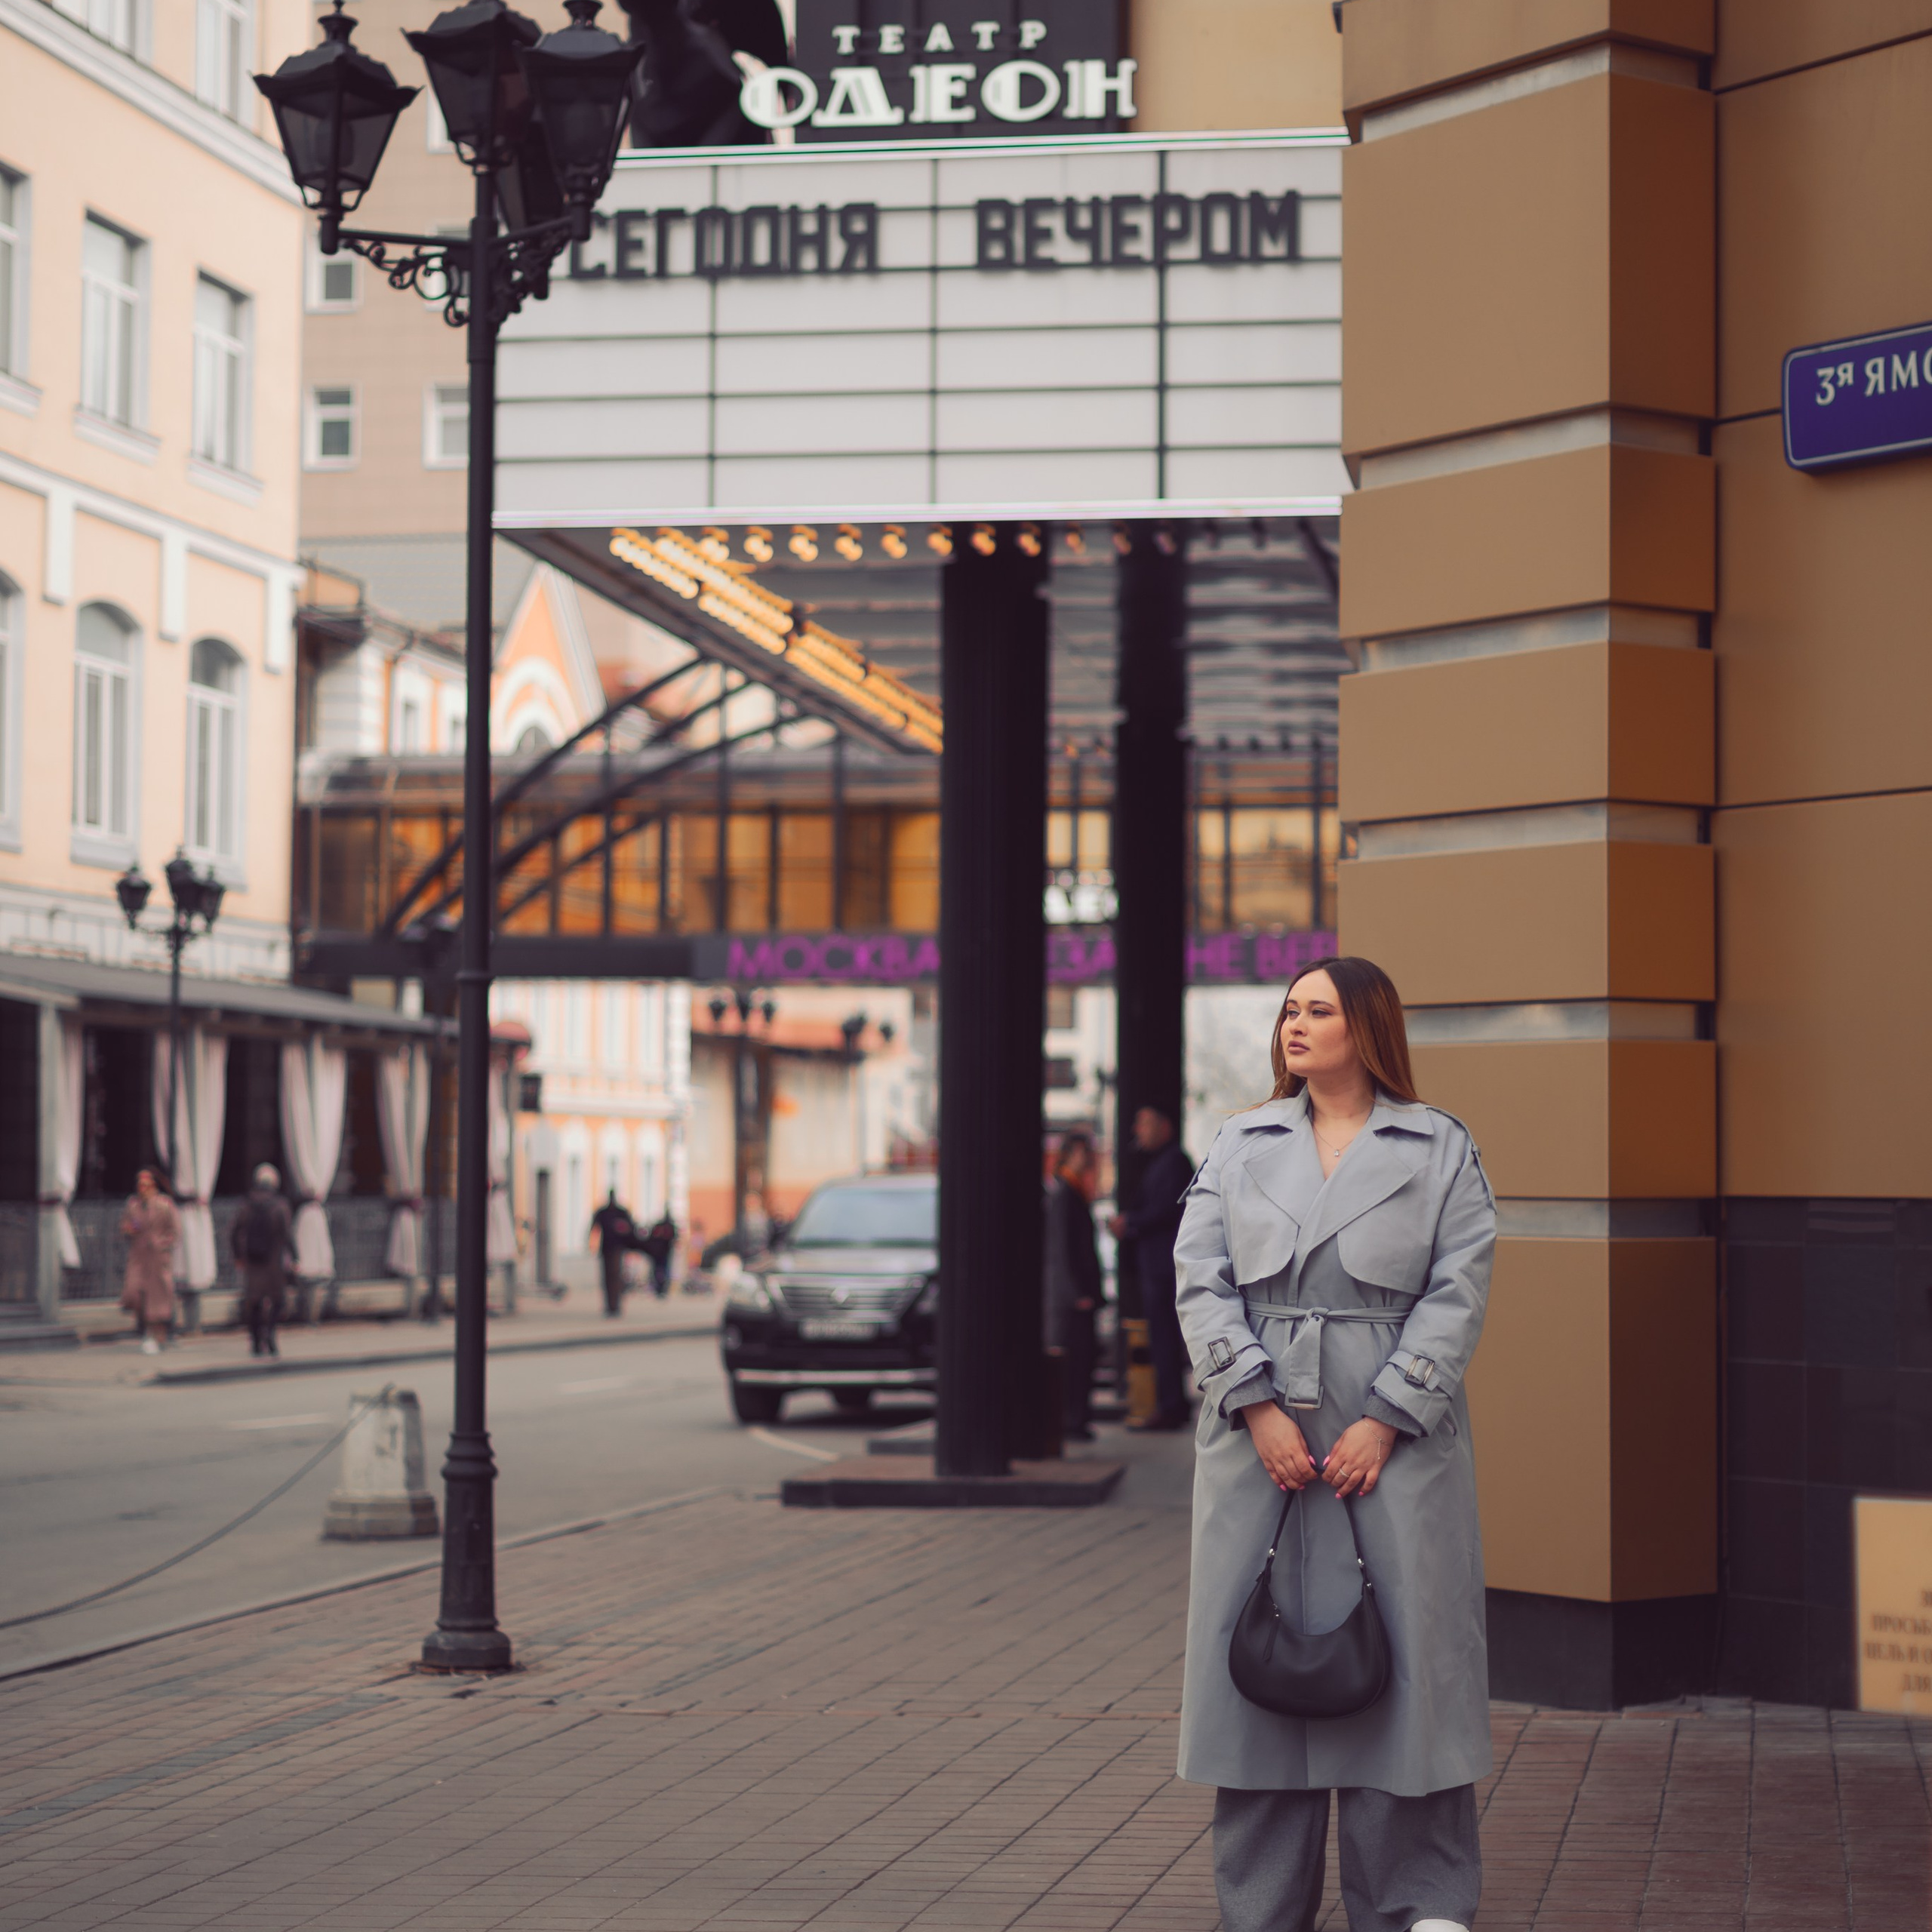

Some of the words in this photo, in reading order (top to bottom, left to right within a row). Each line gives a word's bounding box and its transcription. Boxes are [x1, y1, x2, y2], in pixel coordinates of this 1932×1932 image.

[832, 20, 1047, 54] ТЕАТР
[740, 59, 1137, 128] ОДЕОН
[570, 202, 877, 278] СЕГОДНЯ
[977, 189, 1300, 268] ВЕЧЕРОМ
[727, 936, 941, 980] МОСКВА
